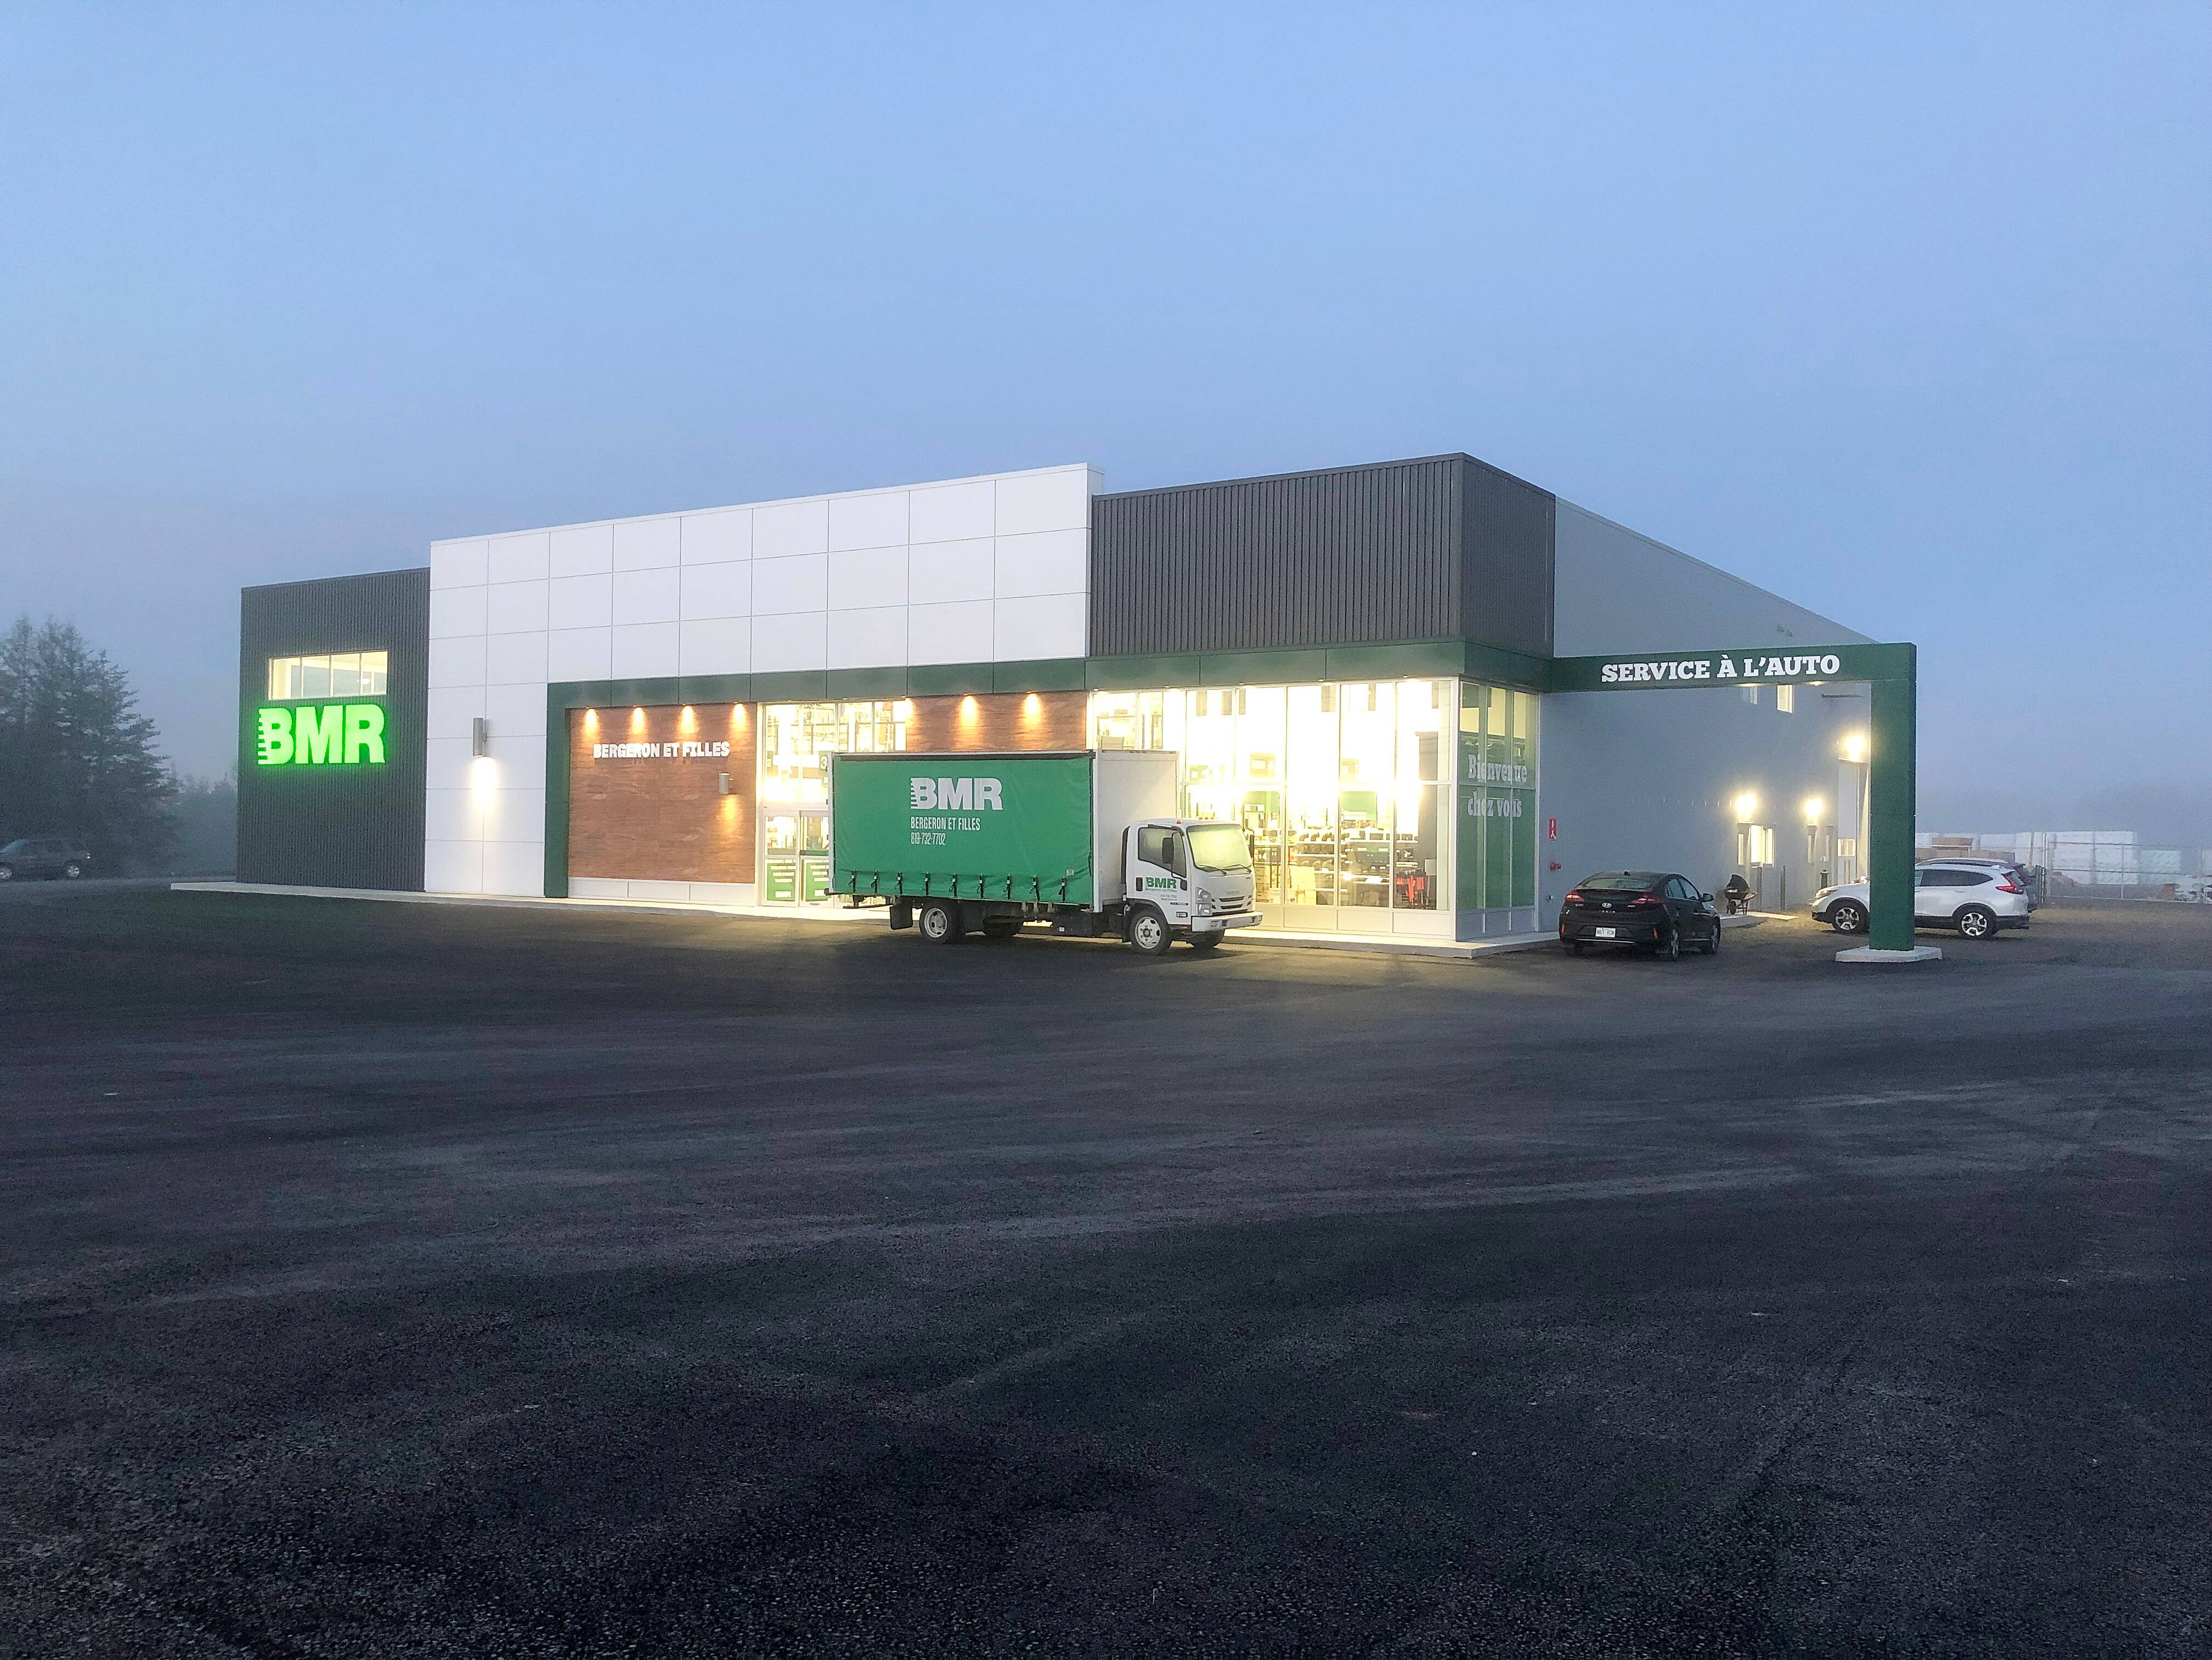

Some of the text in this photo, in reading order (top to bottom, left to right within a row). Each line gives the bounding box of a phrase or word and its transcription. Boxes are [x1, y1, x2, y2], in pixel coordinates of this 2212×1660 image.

[1601, 654, 1840, 682] SERVICE À L'AUTO
[257, 704, 386, 764] BMR
[593, 740, 731, 758] BERGERON ET FILLES
[910, 777, 1003, 811] BMR
[911, 816, 980, 831] BERGERON ET FILLES
[911, 832, 946, 845] 819-732-7702
[1145, 876, 1177, 888] BMR
